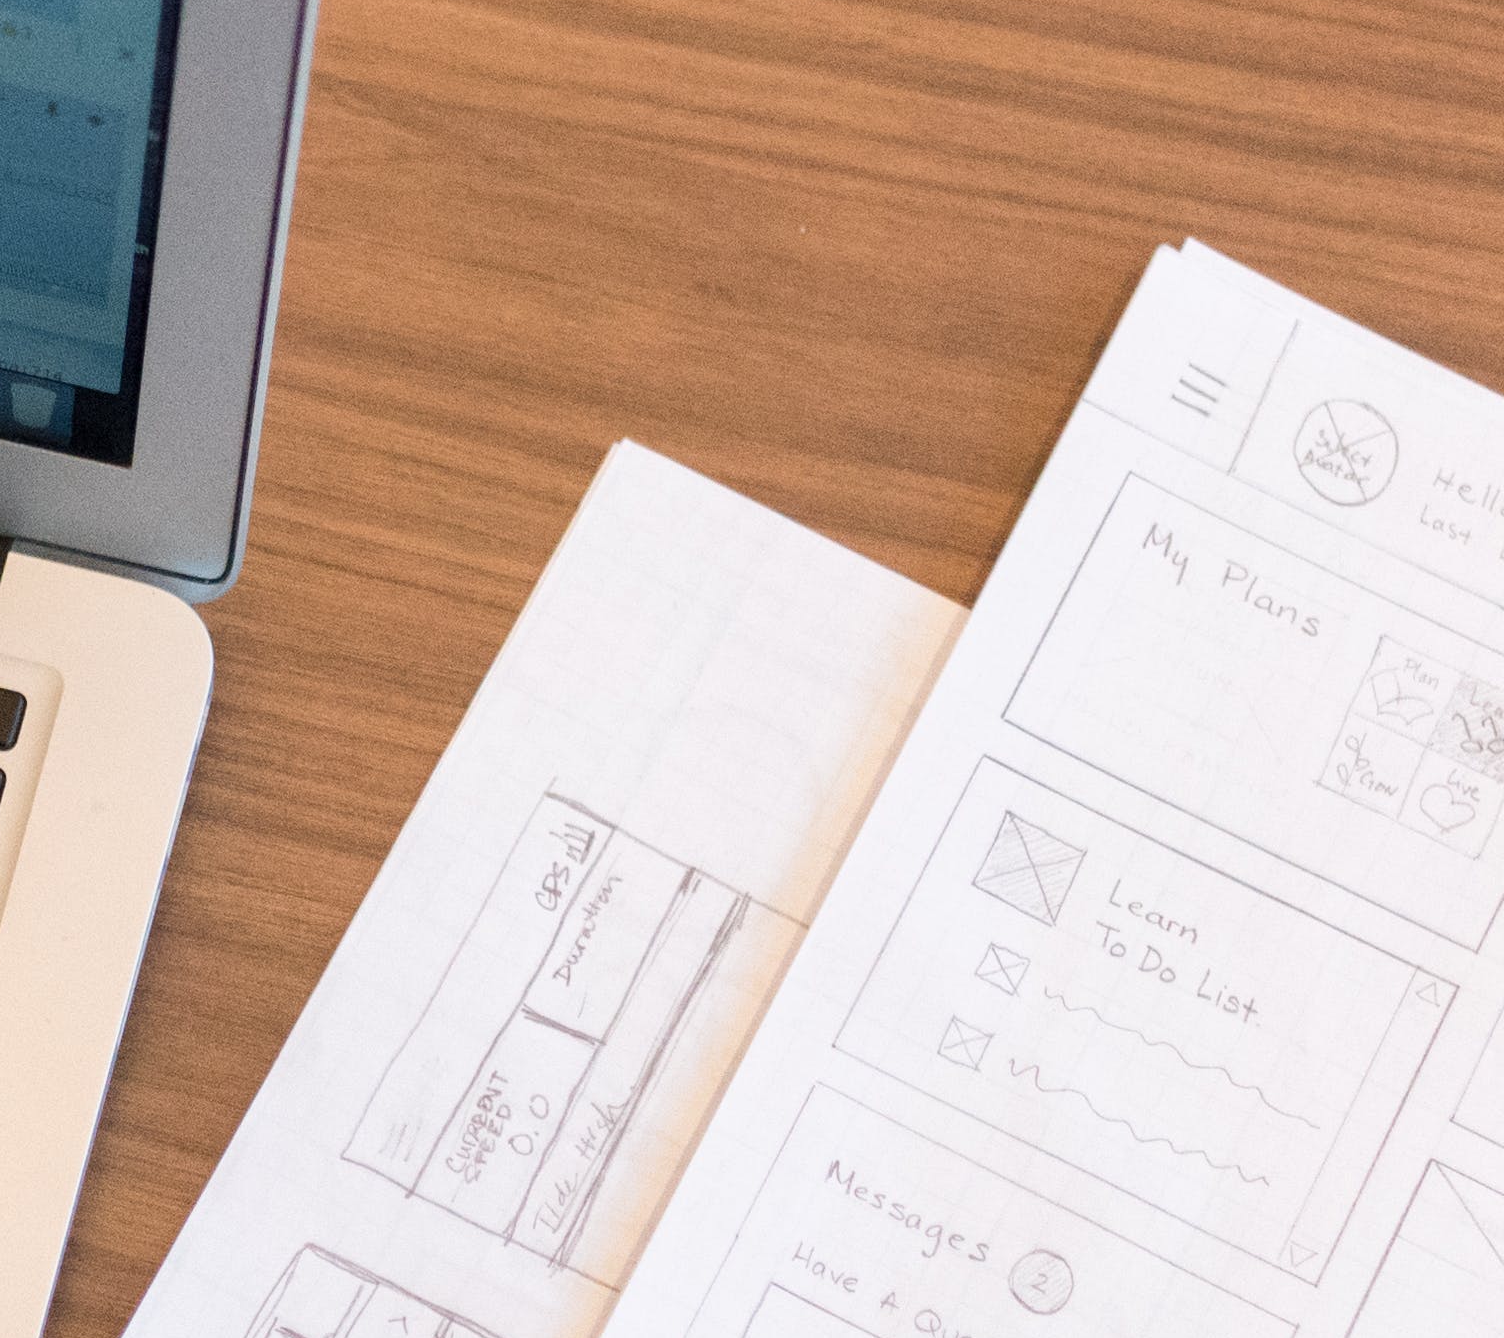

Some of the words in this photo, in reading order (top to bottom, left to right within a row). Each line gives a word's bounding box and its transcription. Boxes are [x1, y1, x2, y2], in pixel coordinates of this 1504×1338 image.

[1418, 503, 1473, 545] Last
[1141, 521, 1190, 587] My
[1220, 558, 1321, 639] Plans
[1399, 657, 1444, 692] Plan
[535, 859, 572, 913] GPS
[1107, 877, 1200, 946] Learn
[1095, 919, 1128, 960] To
[1137, 943, 1178, 985] Do
[463, 1102, 513, 1188] SPEED
[506, 1093, 551, 1158] 0.0
[824, 1158, 991, 1264] Messages
[791, 1241, 860, 1295] Have
[879, 1290, 899, 1311] A
